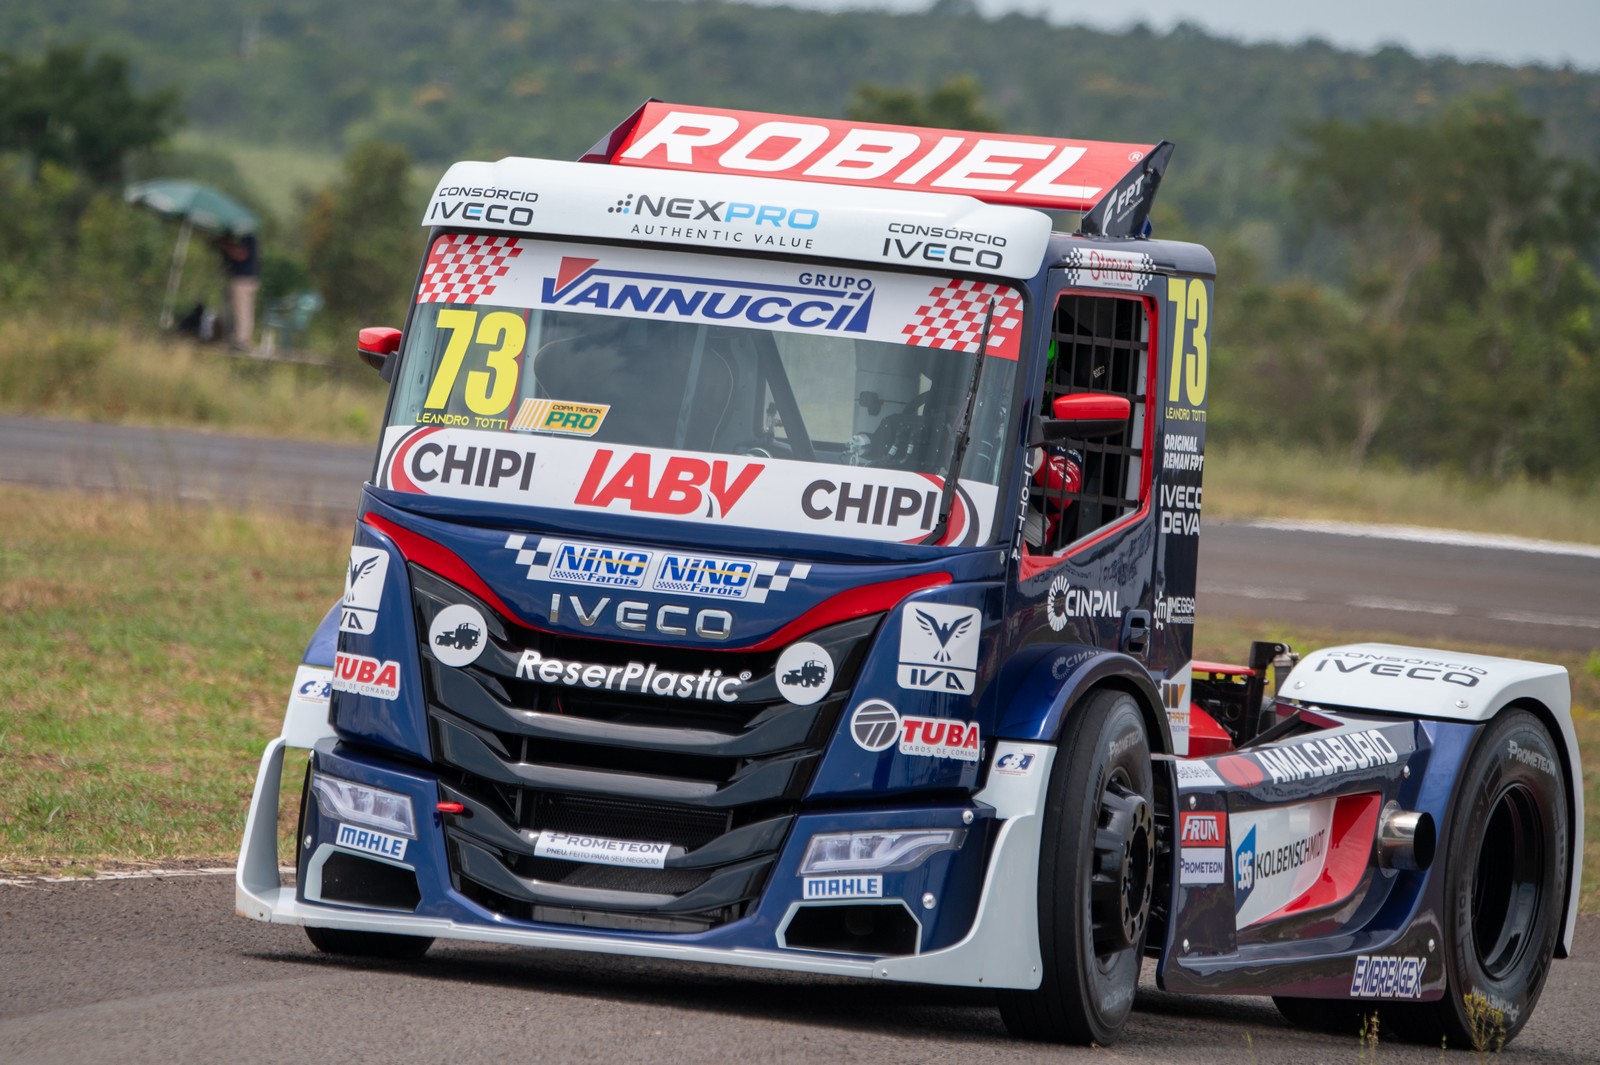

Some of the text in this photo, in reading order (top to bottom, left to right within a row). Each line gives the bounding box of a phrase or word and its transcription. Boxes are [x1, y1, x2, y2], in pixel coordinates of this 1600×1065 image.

[621, 111, 1103, 199] ROBIEL
[438, 186, 539, 203] CONSÓRCIO
[1117, 174, 1145, 214] FPT
[430, 201, 534, 226] IVECO
[634, 194, 820, 230] NEXPRO
[630, 224, 814, 250] AUTHENTIC VALUE
[888, 222, 1007, 247] CONSÓRCIO
[882, 237, 1003, 270] IVECO
[1089, 250, 1133, 281] Otmus
[798, 272, 873, 291] GRUPO
[541, 273, 868, 332] VANNUCCI
[1167, 277, 1208, 407] 73
[423, 308, 527, 415] 73
[415, 412, 508, 431] LEANDRO TOTTI
[544, 410, 599, 430] PRO
[552, 404, 603, 414] COPA TRUCK
[1165, 406, 1207, 423] LEANDRO TOTTI
[1164, 433, 1198, 453] ORIGINAL
[411, 442, 537, 491] CHIPI
[1163, 452, 1204, 472] REMAN FPT
[801, 479, 938, 531] CHIPI
[1161, 511, 1200, 536] DEVA
[587, 571, 639, 587] Faróis
[690, 581, 742, 597] Faróis
[549, 593, 733, 640] IVECO
[1065, 590, 1122, 618] CINPAL
[334, 655, 397, 688] TUBA
[1315, 659, 1480, 688] IVECO
[1326, 651, 1488, 676] CONSÓRCIO
[903, 720, 978, 750] TUBA
[902, 744, 978, 758] CABOS DE COMANDO
[1254, 729, 1398, 785] AMALCABURIO
[1507, 740, 1556, 776] PROMETEON
[340, 826, 403, 857] MAHLE
[1181, 815, 1220, 842] FRUM
[546, 833, 665, 854] PROMETEON
[568, 850, 591, 859] FEITO
[590, 852, 610, 861] PARA
[1255, 828, 1325, 880] KOLBENSCHMIDT
[1180, 857, 1223, 874] PROMETEON
[808, 878, 878, 896] MAHLE
[1351, 956, 1426, 997] EMBREAGEX
